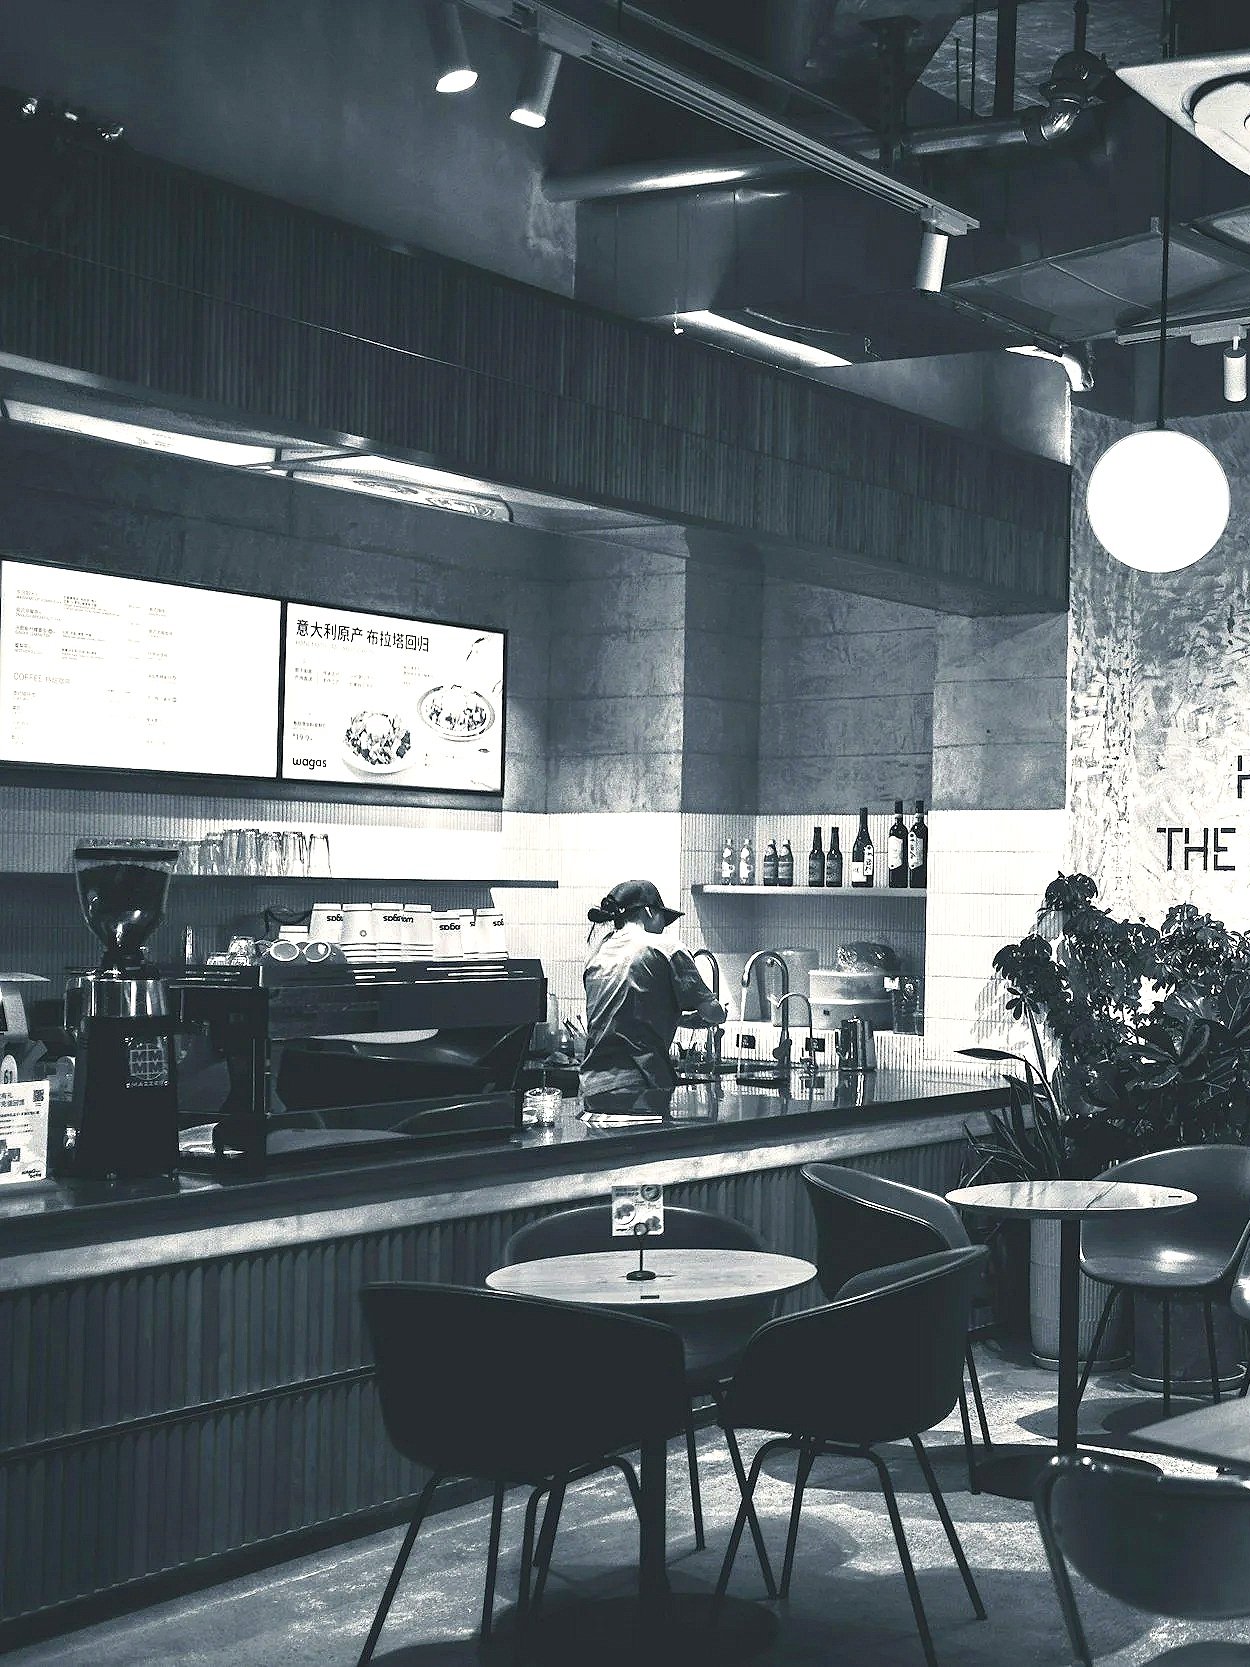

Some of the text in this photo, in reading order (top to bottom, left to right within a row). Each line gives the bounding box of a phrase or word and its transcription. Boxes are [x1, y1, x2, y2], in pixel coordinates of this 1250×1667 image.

[295, 619, 363, 643] 意大利原产
[366, 628, 430, 653] 布拉塔回归
[292, 757, 327, 770] wagas
[1156, 828, 1237, 871] THE
[326, 913, 344, 922] gas
[439, 922, 460, 931] agas
